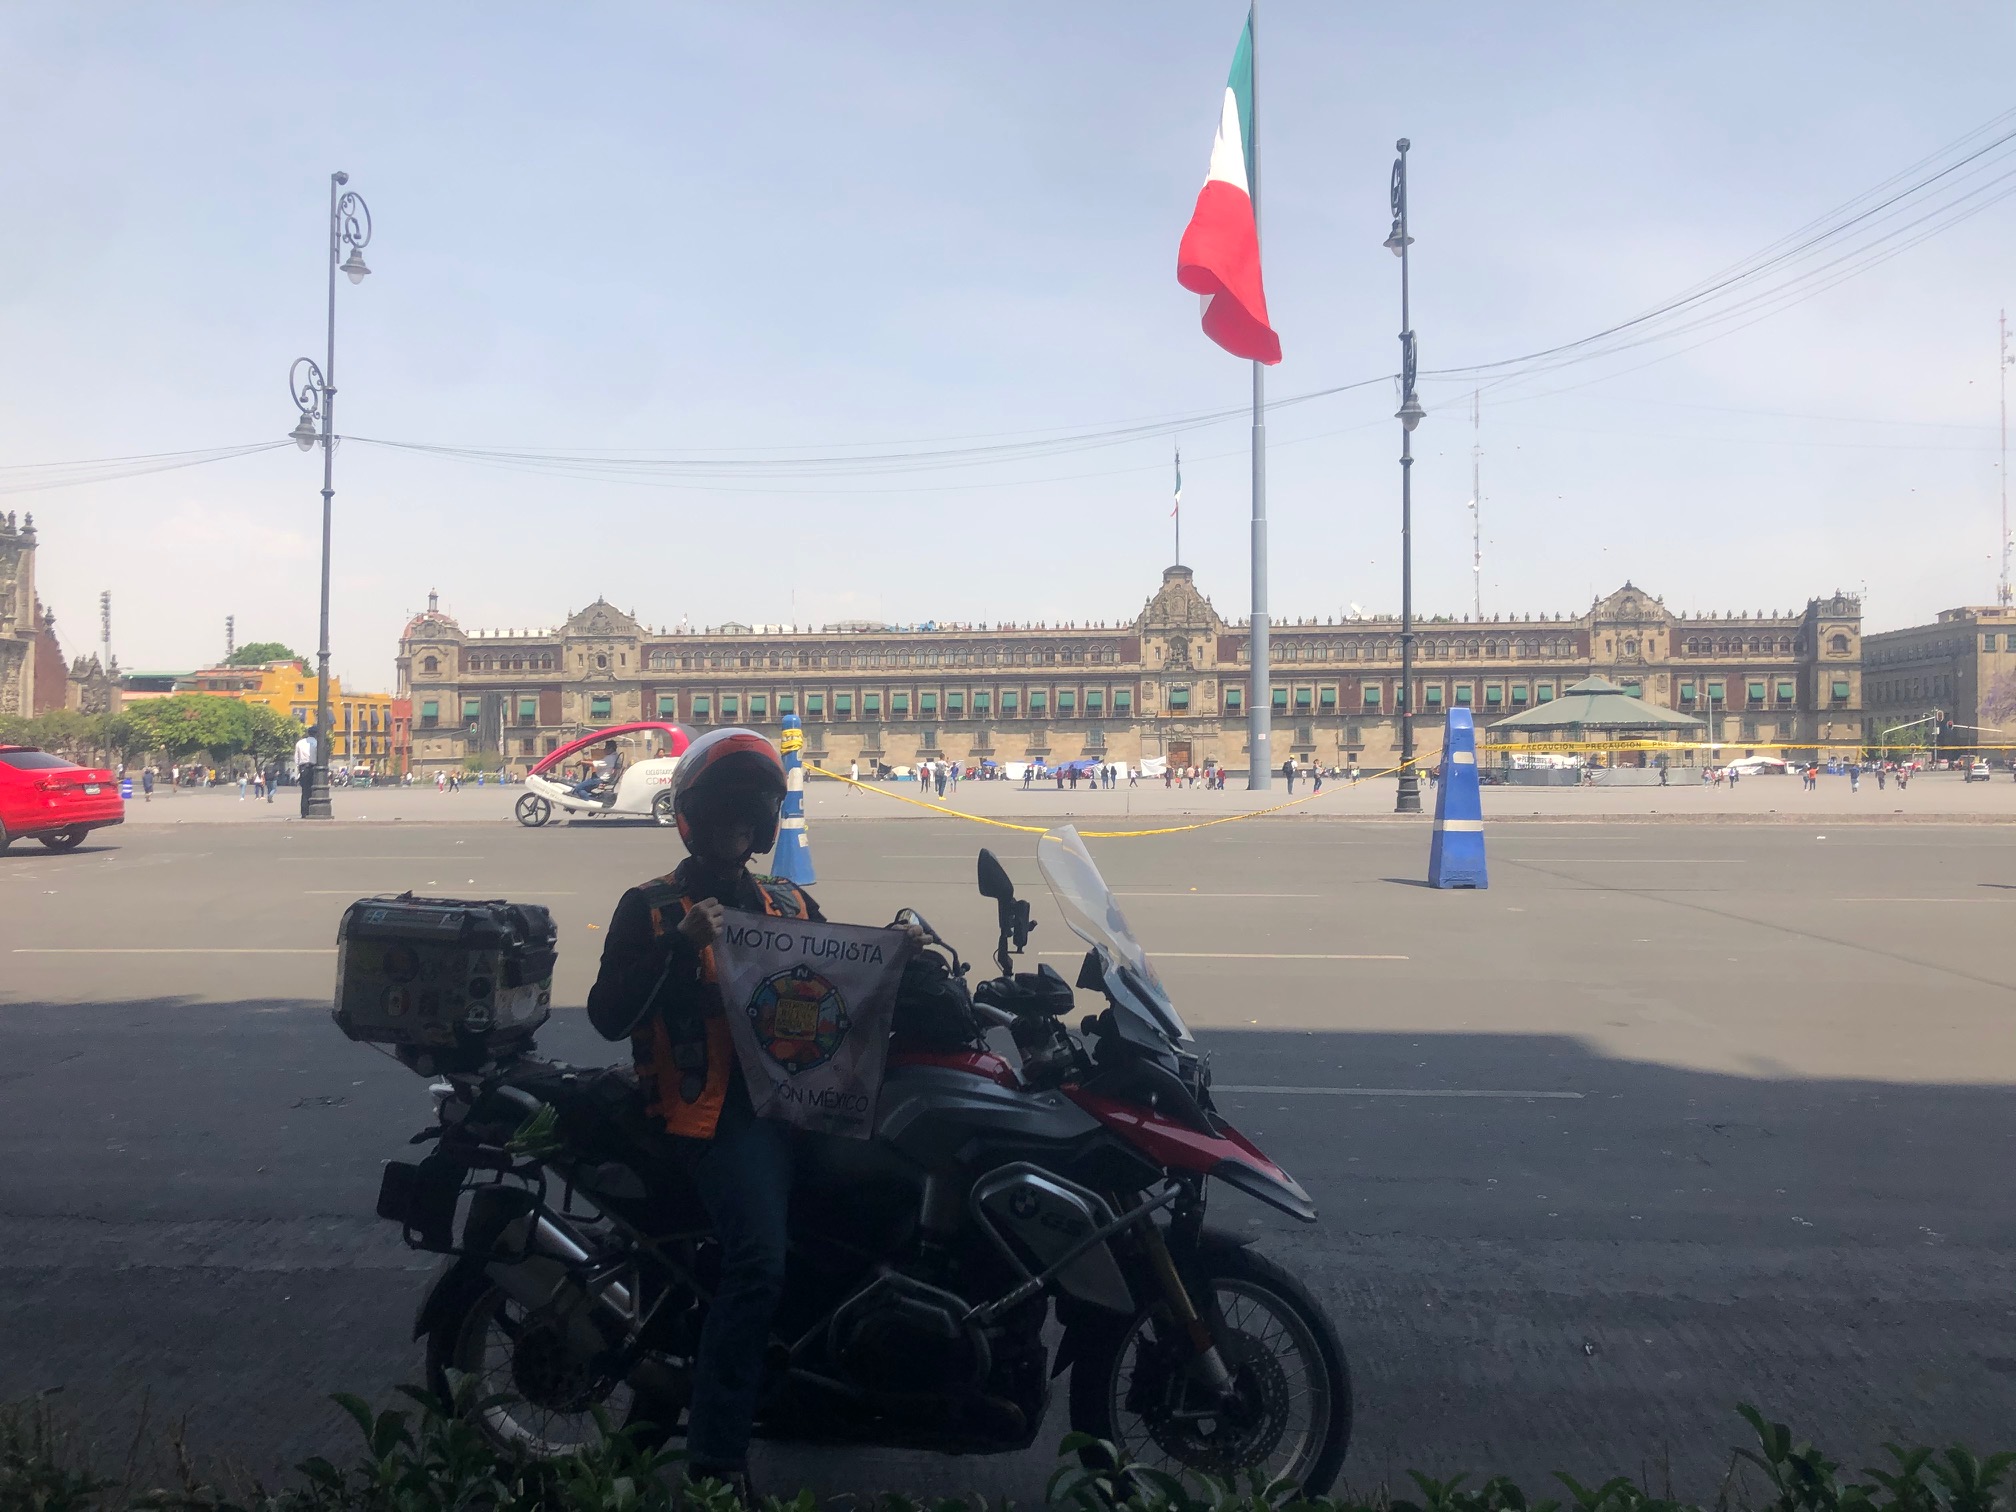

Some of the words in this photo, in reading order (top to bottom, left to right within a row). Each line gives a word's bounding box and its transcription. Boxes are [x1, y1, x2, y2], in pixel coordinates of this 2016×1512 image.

[1586, 741, 1642, 750] PRECAUCION
[646, 777, 672, 785] CDMX
[726, 925, 793, 952] MOTO
[801, 936, 883, 964] TURISTA
[797, 968, 808, 977] N
[808, 1086, 869, 1113] MÉXICO
